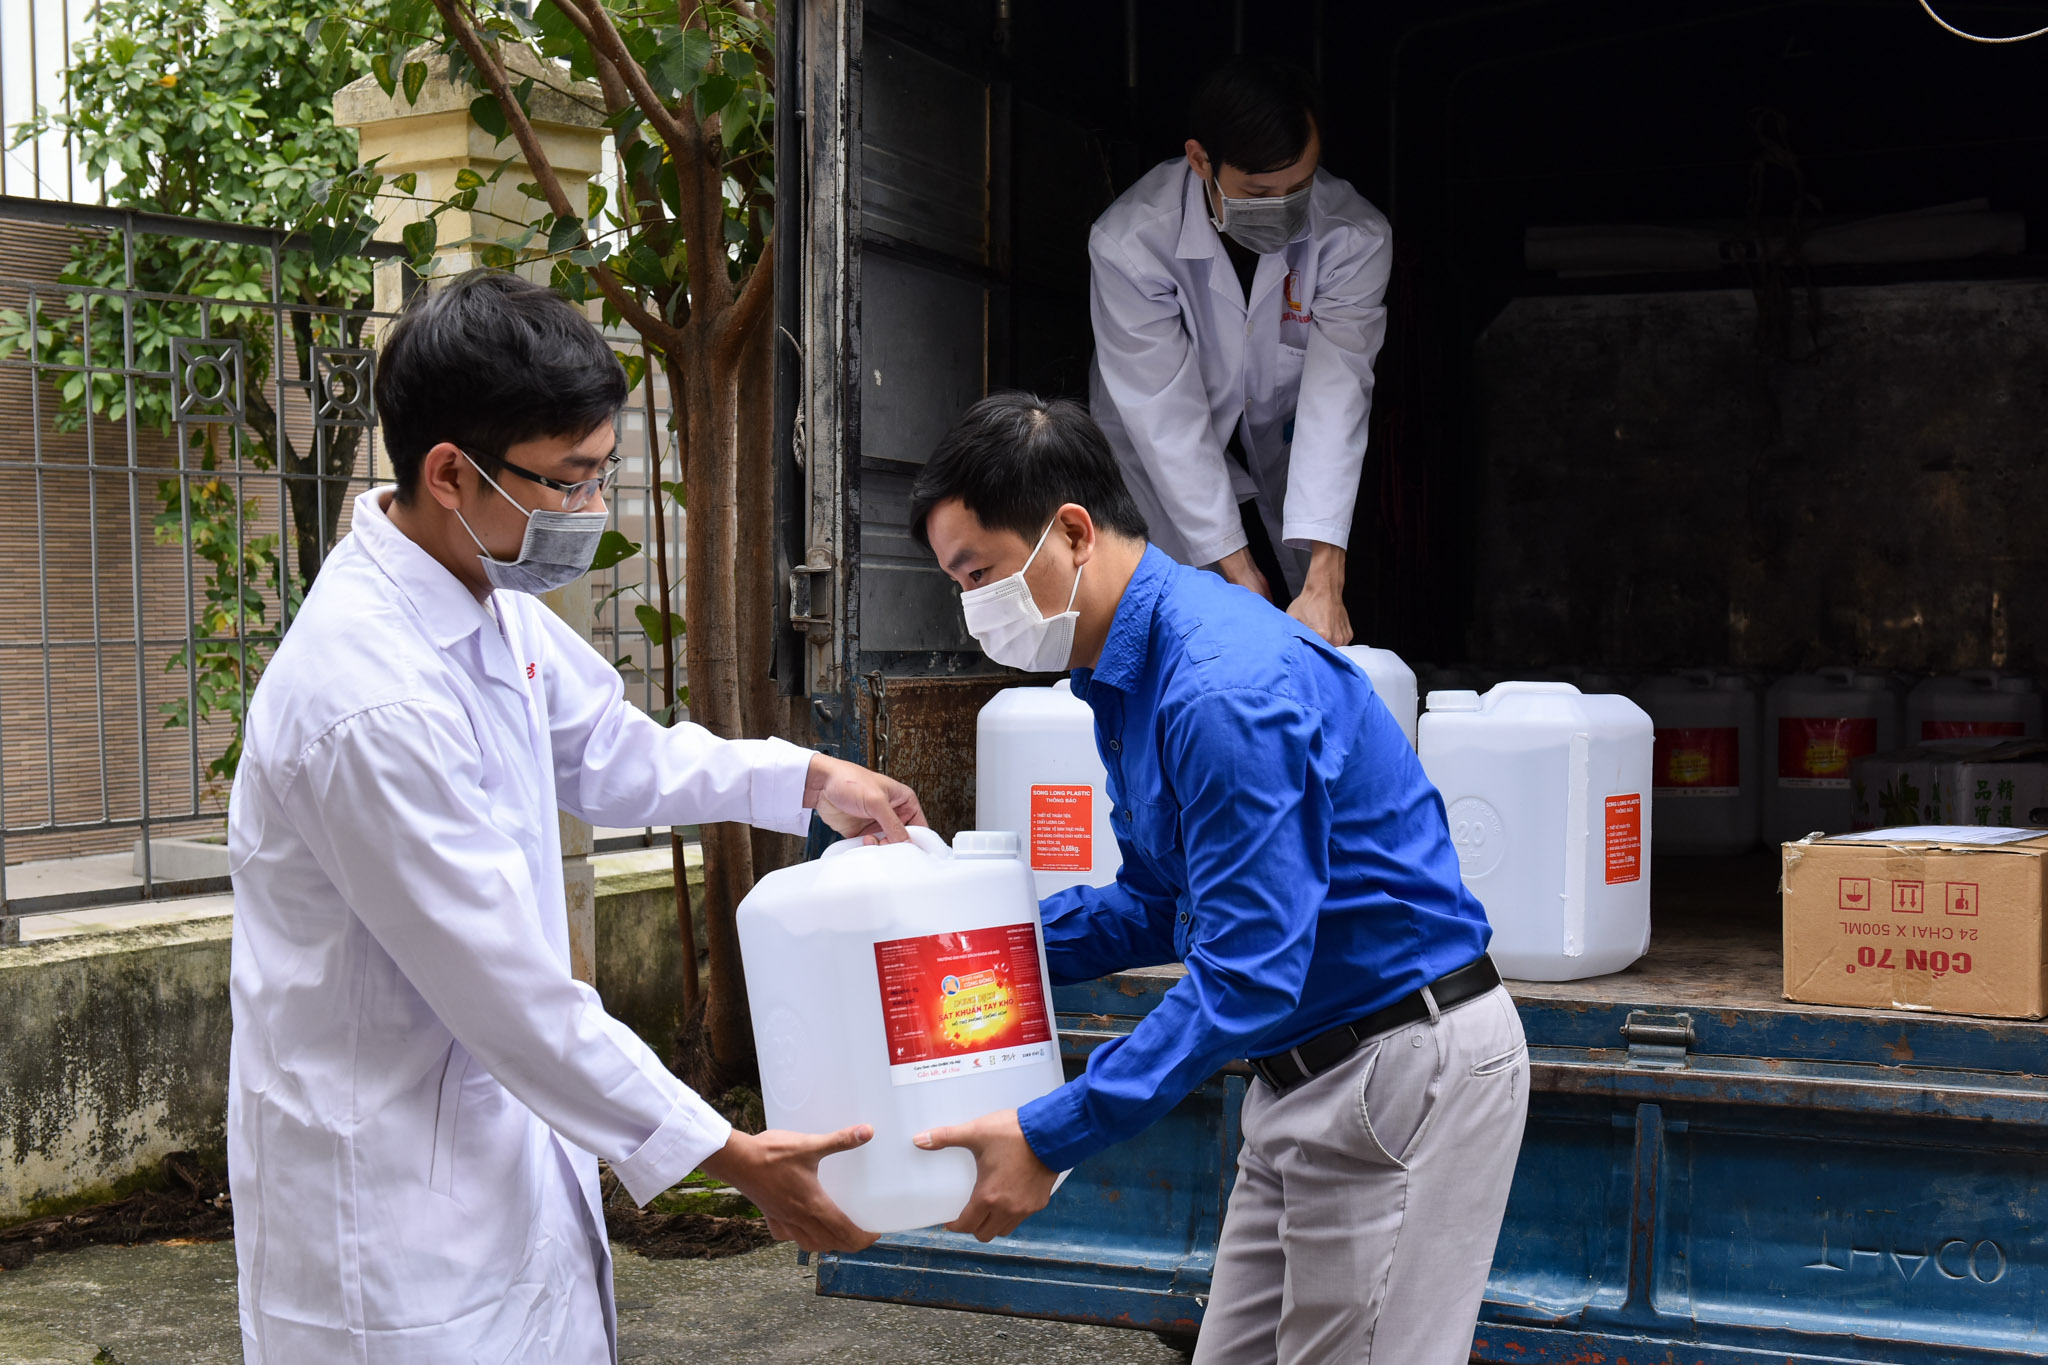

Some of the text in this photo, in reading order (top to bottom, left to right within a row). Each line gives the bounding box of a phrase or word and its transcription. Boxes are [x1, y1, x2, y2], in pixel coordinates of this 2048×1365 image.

[1839, 921, 1979, 941] 24 CHAI X 500ML
[1905, 948, 1972, 979] CỒN
[983, 1001, 997, 1011] TAY
